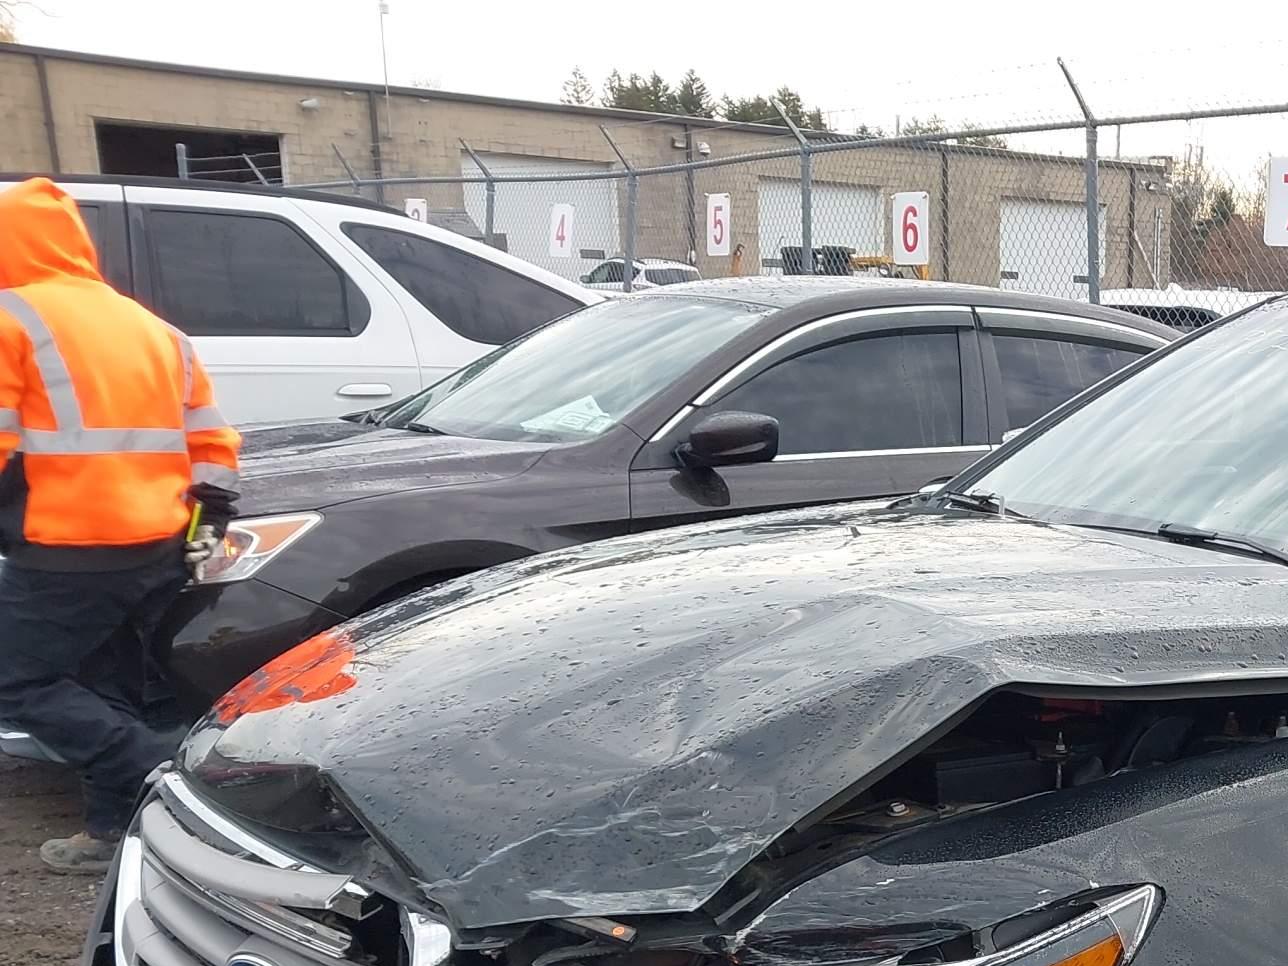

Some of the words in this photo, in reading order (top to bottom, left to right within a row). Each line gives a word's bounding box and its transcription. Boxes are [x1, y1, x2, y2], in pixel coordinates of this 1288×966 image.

[555, 214, 566, 248] 4
[713, 206, 723, 245] 5
[902, 205, 919, 253] 6
